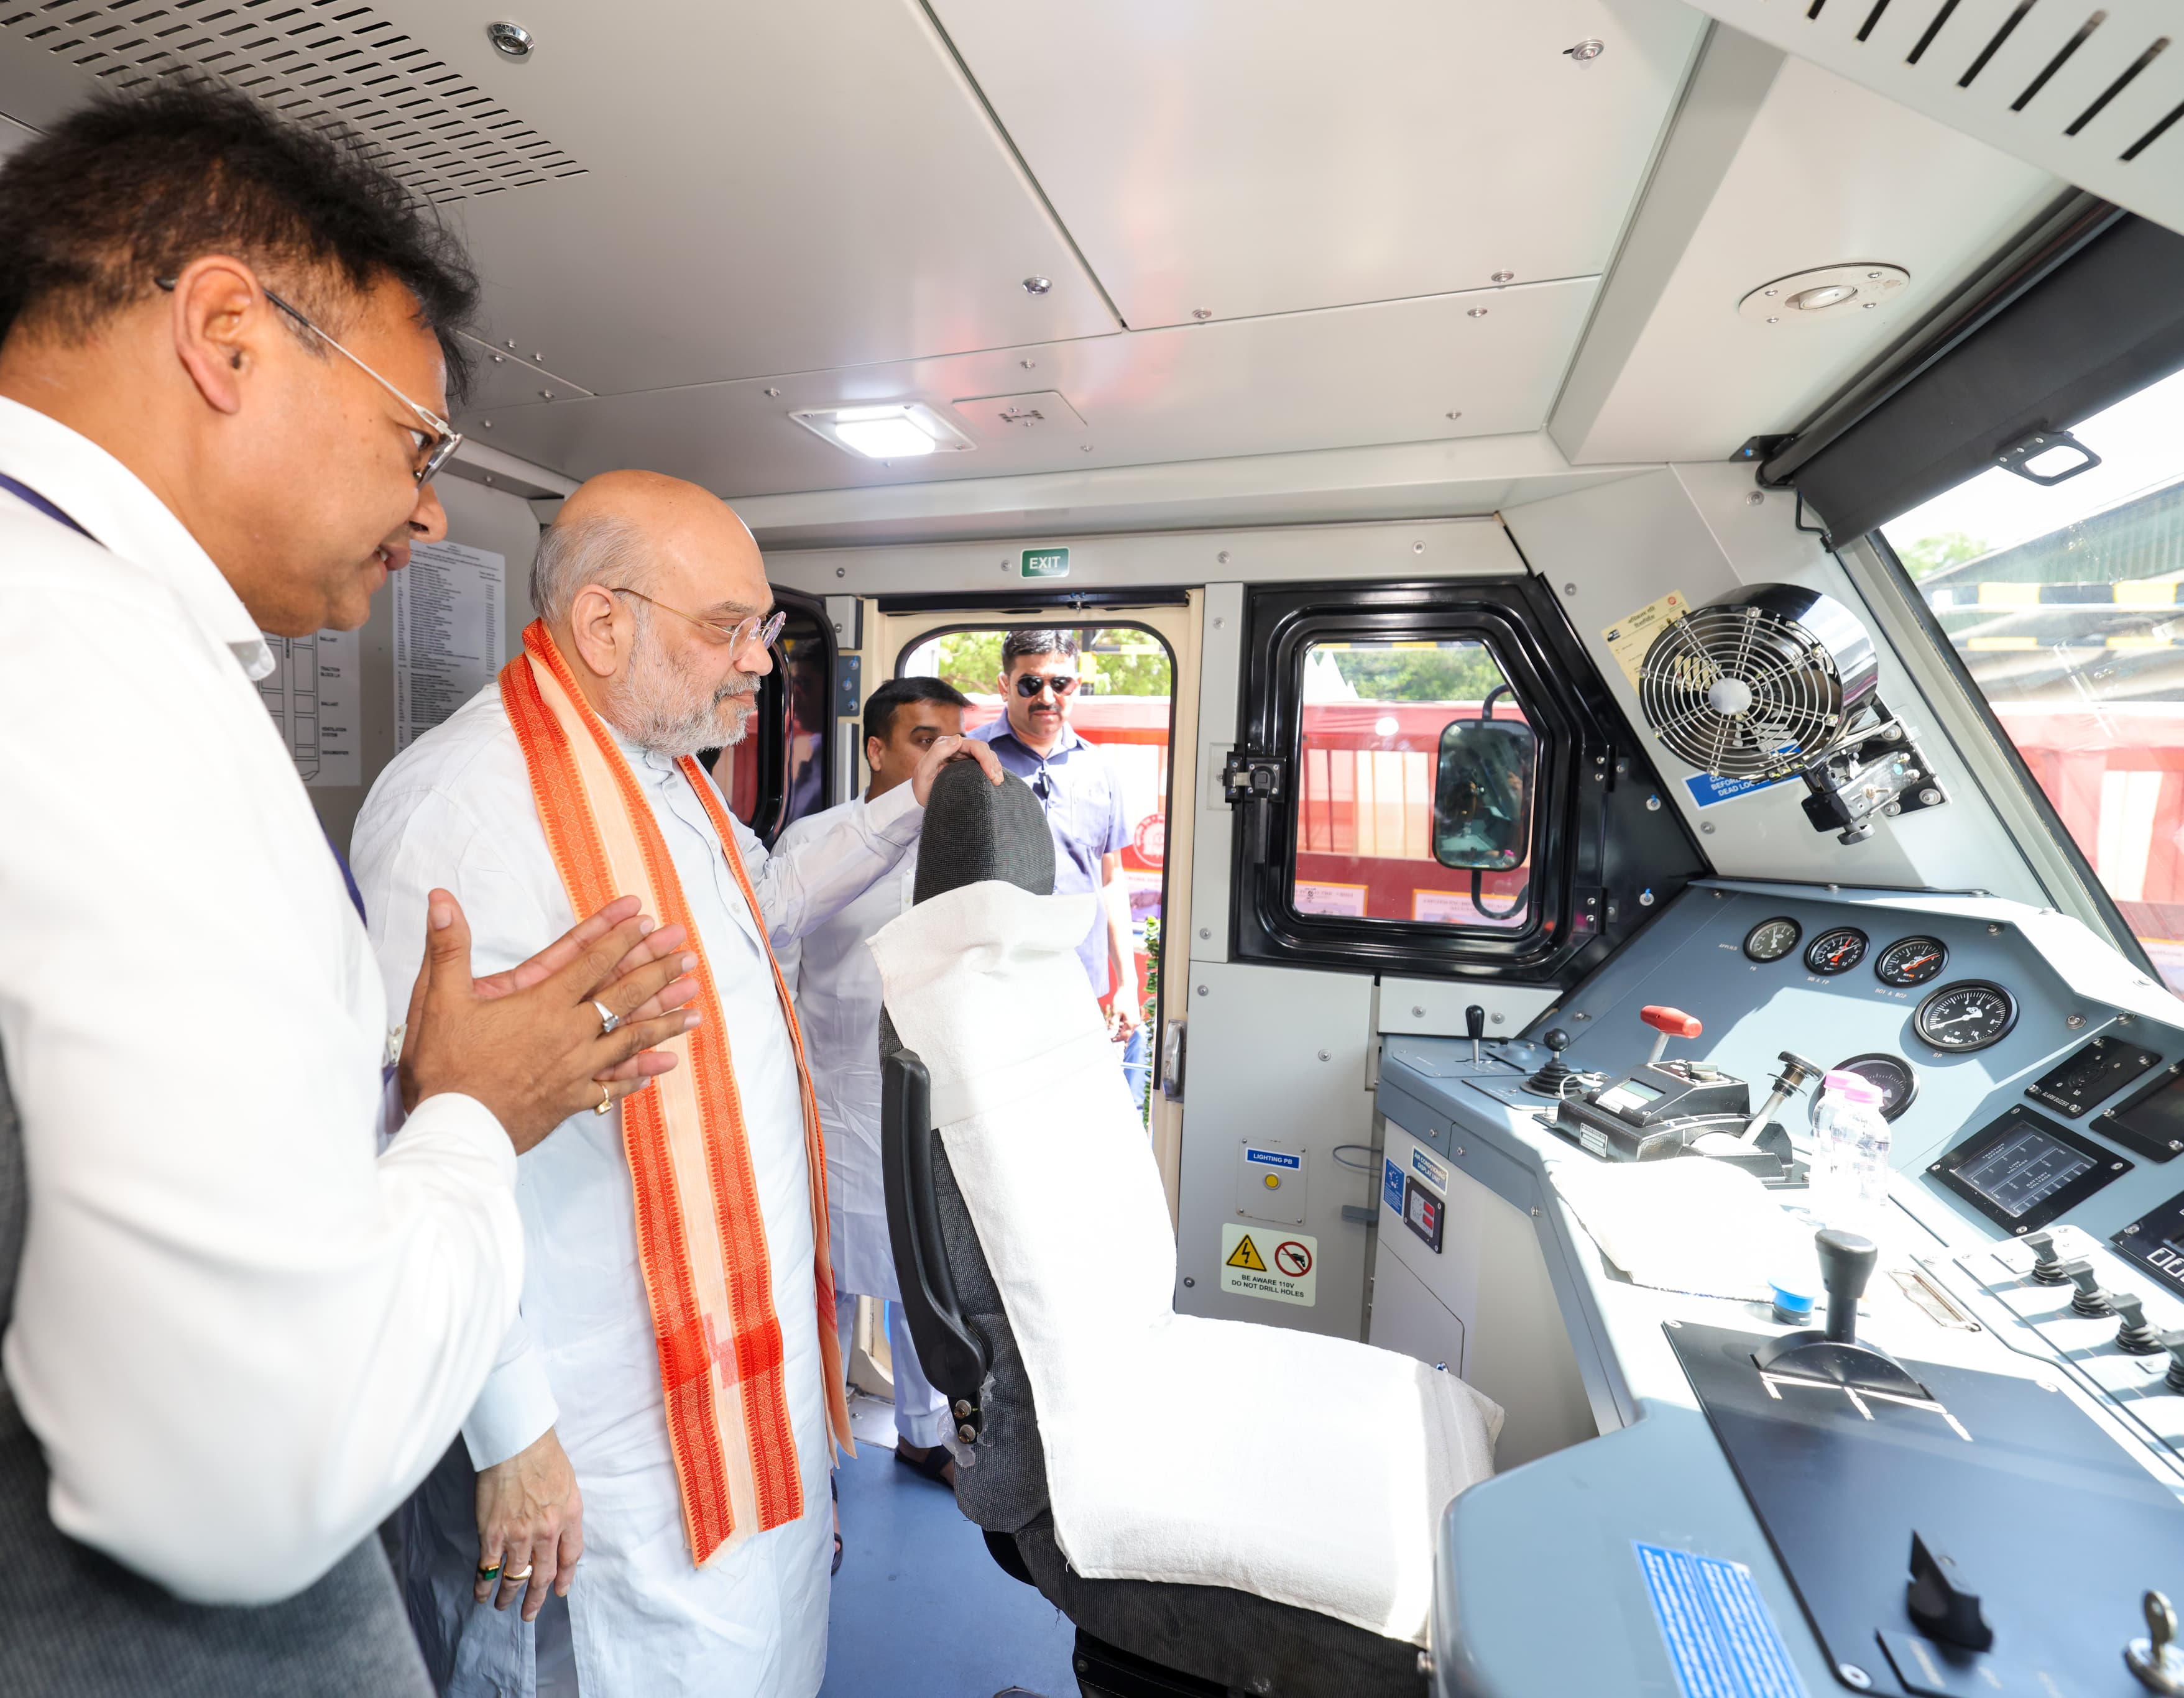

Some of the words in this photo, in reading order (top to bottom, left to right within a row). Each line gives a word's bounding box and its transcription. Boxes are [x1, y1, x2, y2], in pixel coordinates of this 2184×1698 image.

[1029, 556, 1061, 569] EXIT
[1718, 786, 1739, 796] DEAD
[2042, 1091, 2056, 1100] ALARM
[2053, 1097, 2070, 1107] BUZZER
[1982, 1143, 2004, 1159] TRACTION
[1988, 1147, 2004, 1159] EFFORT
[1253, 1154, 1282, 1163] LIGHTING
[2009, 1160, 2020, 1168] LINE
[1417, 1162, 1432, 1177] DISPLAY
[1432, 1173, 1440, 1184] UNIT
[1421, 1157, 1446, 1180] CONDITIONING
[2007, 1159, 2028, 1174] VOLTAGE
[2026, 1172, 2047, 1186] BATTERY
[2029, 1174, 2051, 1188] VOLTAGE
[1252, 1276, 1277, 1285] AWARE
[1259, 1284, 1279, 1293] DRILL
[1281, 1288, 1304, 1298] HOLES
